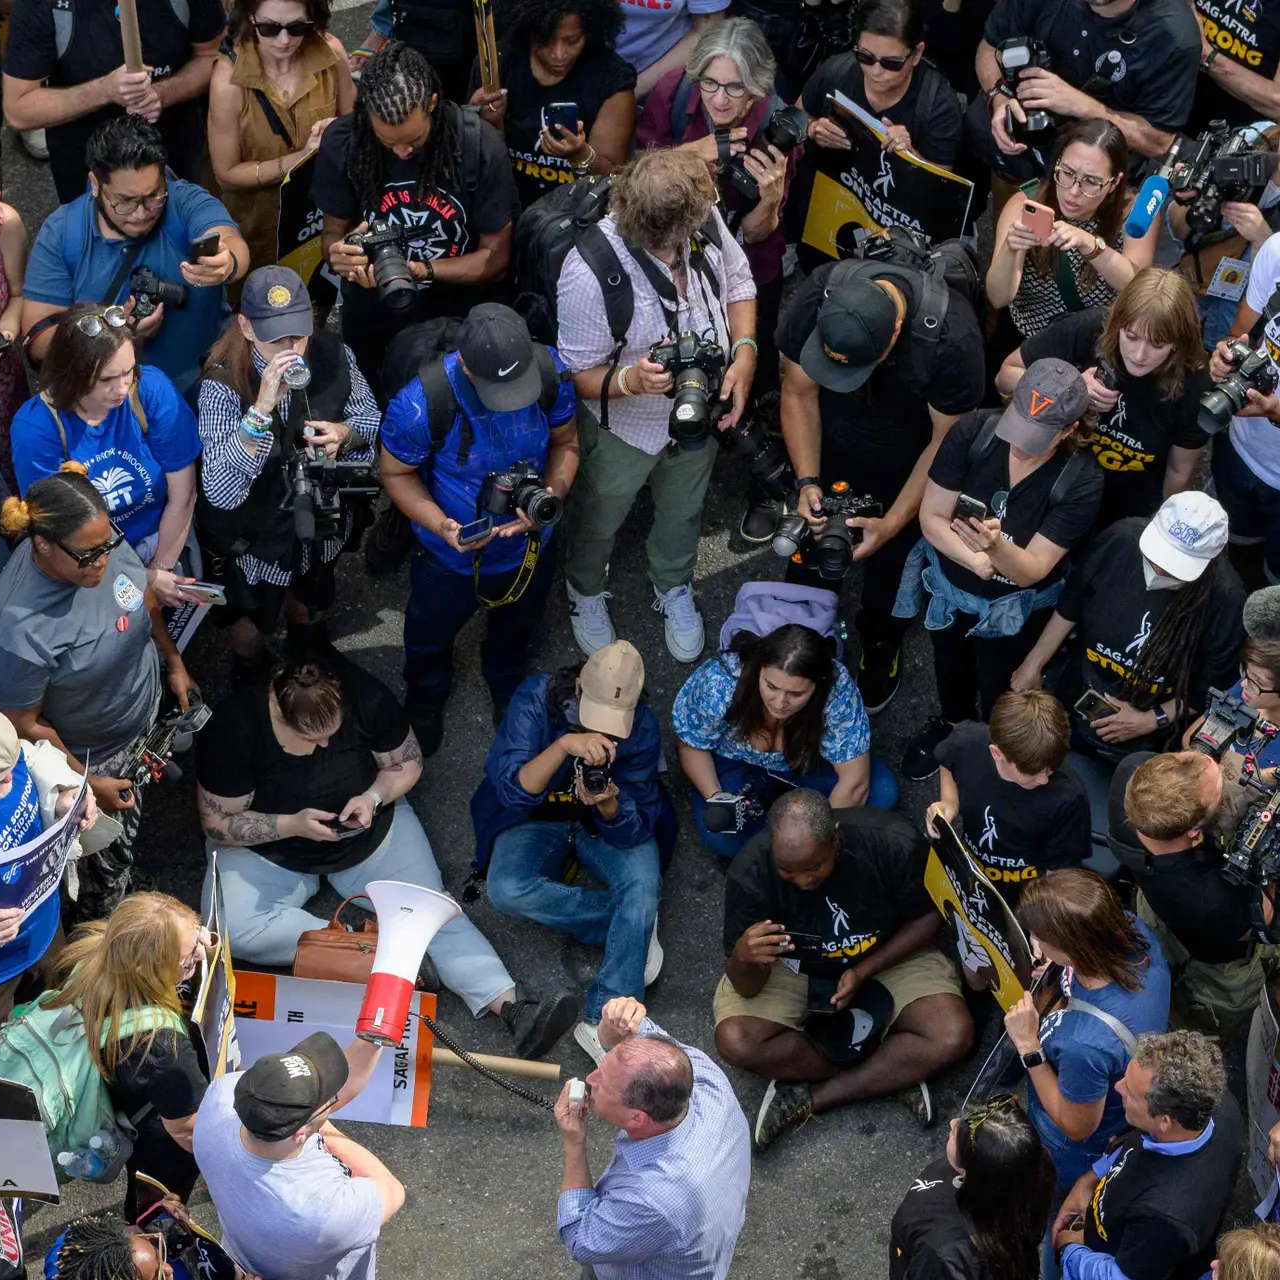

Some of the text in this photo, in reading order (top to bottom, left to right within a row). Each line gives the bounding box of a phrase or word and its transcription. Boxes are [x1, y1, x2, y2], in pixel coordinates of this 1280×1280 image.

[840, 172, 859, 194] ON
[1145, 196, 1157, 216] AFP
[121, 450, 152, 489] BROOKLYN
[1174, 519, 1202, 541] ACTORS
